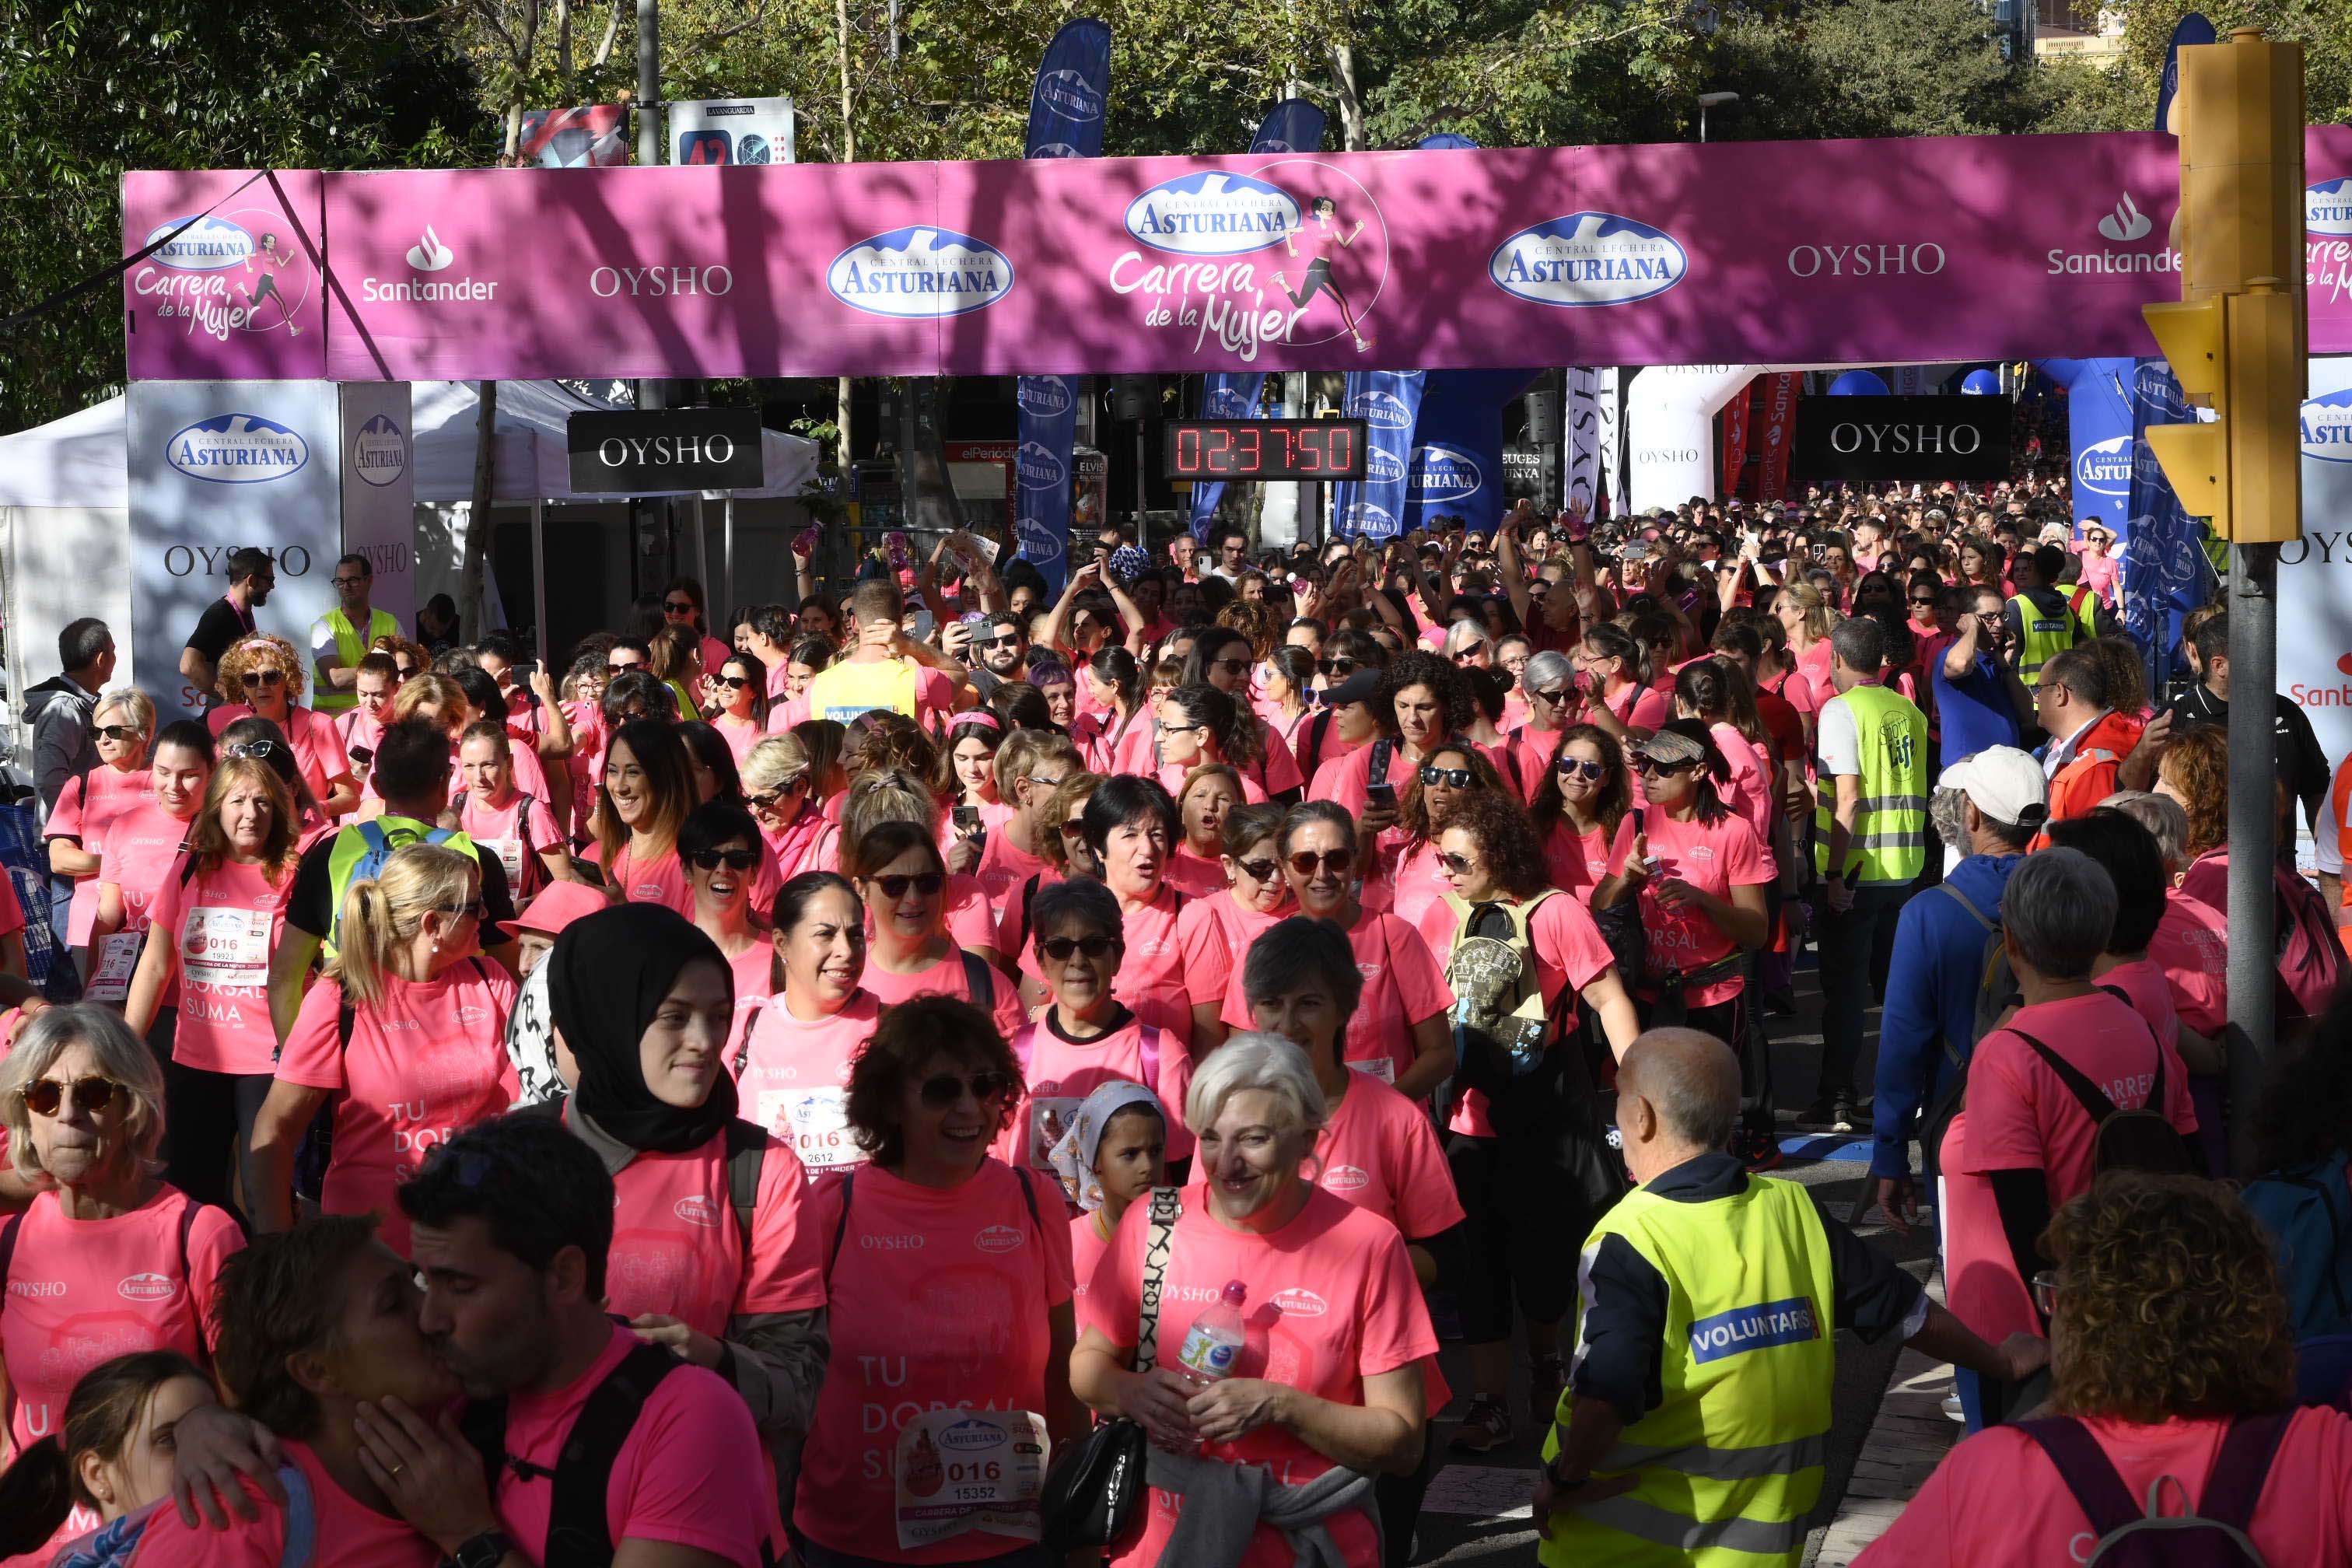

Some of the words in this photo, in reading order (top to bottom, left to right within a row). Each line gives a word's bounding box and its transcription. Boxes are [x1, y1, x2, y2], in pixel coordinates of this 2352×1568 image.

[716, 106, 754, 116] VANGUARDIA
[1165, 199, 1221, 210] CENTRAL
[1226, 198, 1283, 208] LECHERA
[1138, 203, 1289, 235] ASTURIANA
[152, 235, 247, 256] ASTURIANA
[1535, 245, 1596, 255] CENTRAL
[1602, 243, 1665, 253] LECHERA
[870, 257, 929, 267] CENTRAL
[1504, 248, 1672, 283] ASTURIANA
[1787, 243, 1945, 277] OYSHO
[2047, 247, 2182, 275] Santande
[135, 266, 226, 296] Carrera
[590, 265, 733, 297] OYSHO
[842, 261, 1000, 294] ASTURIANA
[1109, 251, 1255, 294] Carrera
[362, 277, 498, 302] Santander
[157, 297, 173, 317] de
[177, 296, 191, 317] la
[188, 292, 261, 341] Mujer
[1145, 298, 1172, 327] de
[1178, 296, 1198, 327] la
[1194, 289, 1310, 362] Mujer
[1771, 373, 1791, 422] Santa
[1570, 367, 1595, 510] OYSH
[1831, 422, 1981, 454] OYSHO
[177, 439, 299, 466] ASTURIANA
[357, 440, 403, 468] ASTURIANA
[598, 434, 734, 467] OYSHO
[962, 446, 1013, 459] elPeriódi
[1178, 429, 1350, 471] 02:37:50
[1503, 453, 1541, 464] EUGES
[1639, 448, 1699, 465] OYSHO
[1080, 462, 1104, 471] ELVIS
[1367, 463, 1400, 478] RIANA
[1504, 468, 1540, 478] UNYA
[825, 710, 866, 720] VOLUN
[1879, 716, 1909, 746] Sport
[210, 938, 238, 950] 016
[212, 952, 235, 961] 19923
[187, 997, 243, 1022] SUMA
[389, 1102, 425, 1120] TU
[800, 1132, 840, 1150] 016
[808, 1153, 834, 1163] 2612
[1325, 1174, 1367, 1185] ASTURIANA
[860, 1235, 925, 1250] OYSHO
[10, 1280, 67, 1298] OYSHO
[120, 1282, 174, 1296] ASTURIANA
[1273, 1297, 1325, 1313] ASTURIANA
[856, 1355, 908, 1388] TU
[944, 1432, 1003, 1444] ASTURIANA
[948, 1461, 1002, 1482] 016
[954, 1486, 996, 1500] 15352
[915, 1507, 959, 1517] CARRERA
